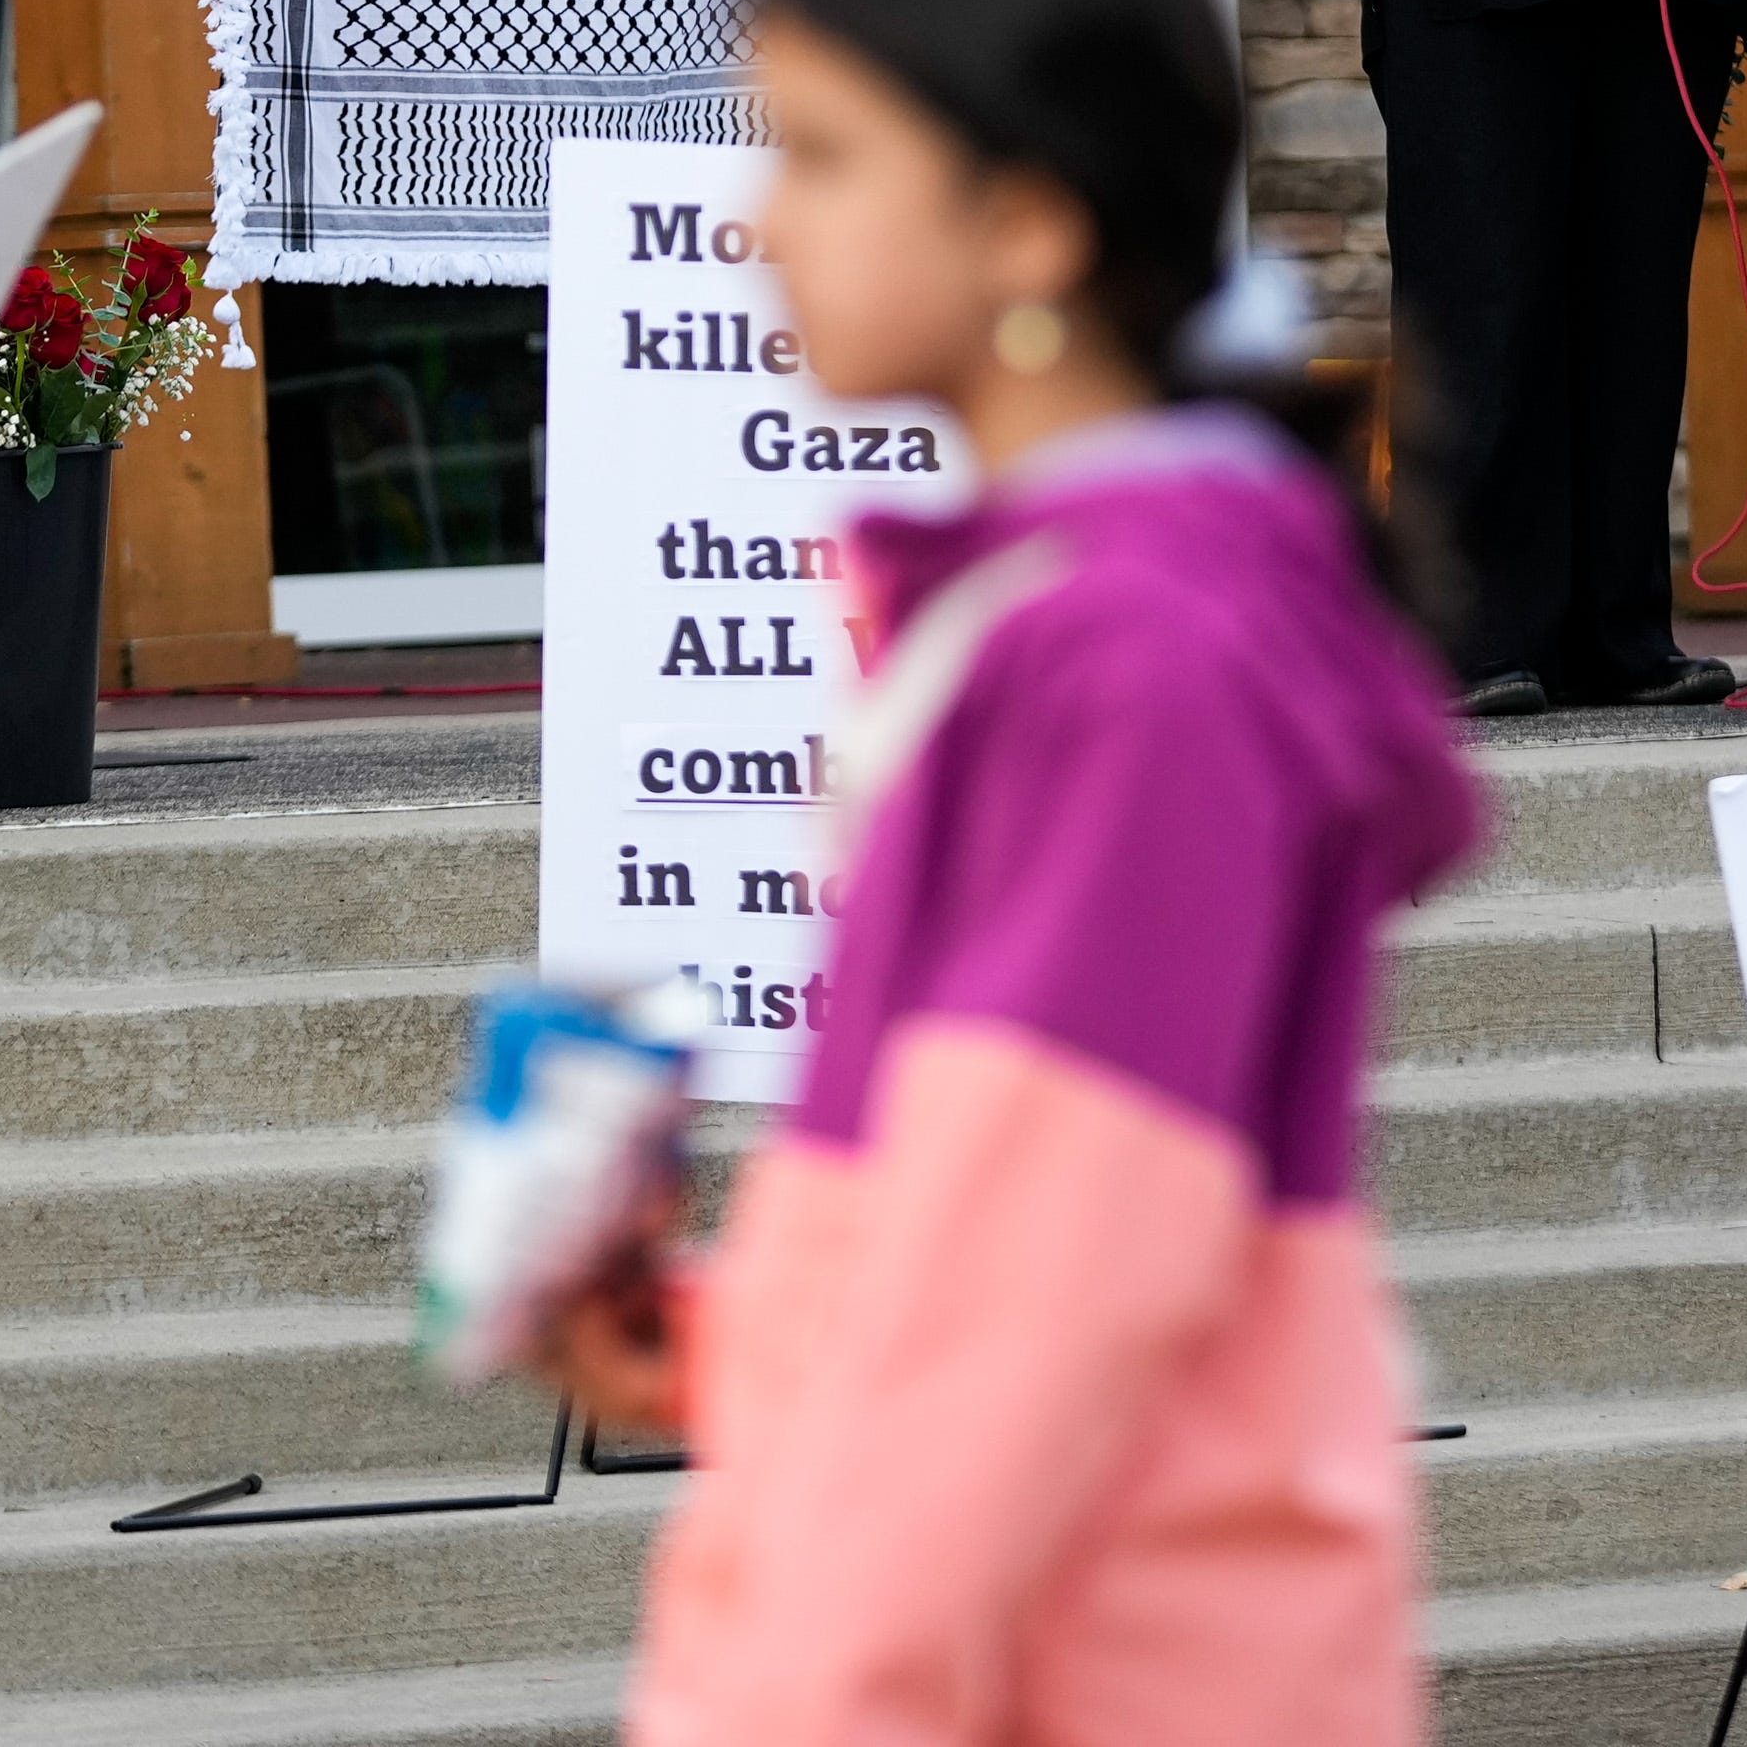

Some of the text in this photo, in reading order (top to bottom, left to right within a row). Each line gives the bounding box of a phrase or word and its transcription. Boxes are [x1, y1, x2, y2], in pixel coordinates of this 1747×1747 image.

[622, 310, 816, 374] kille
[742, 410, 941, 473] Gaza
[657, 519, 844, 581] than
[660, 617, 814, 677] ALL
[618, 846, 694, 907] in
